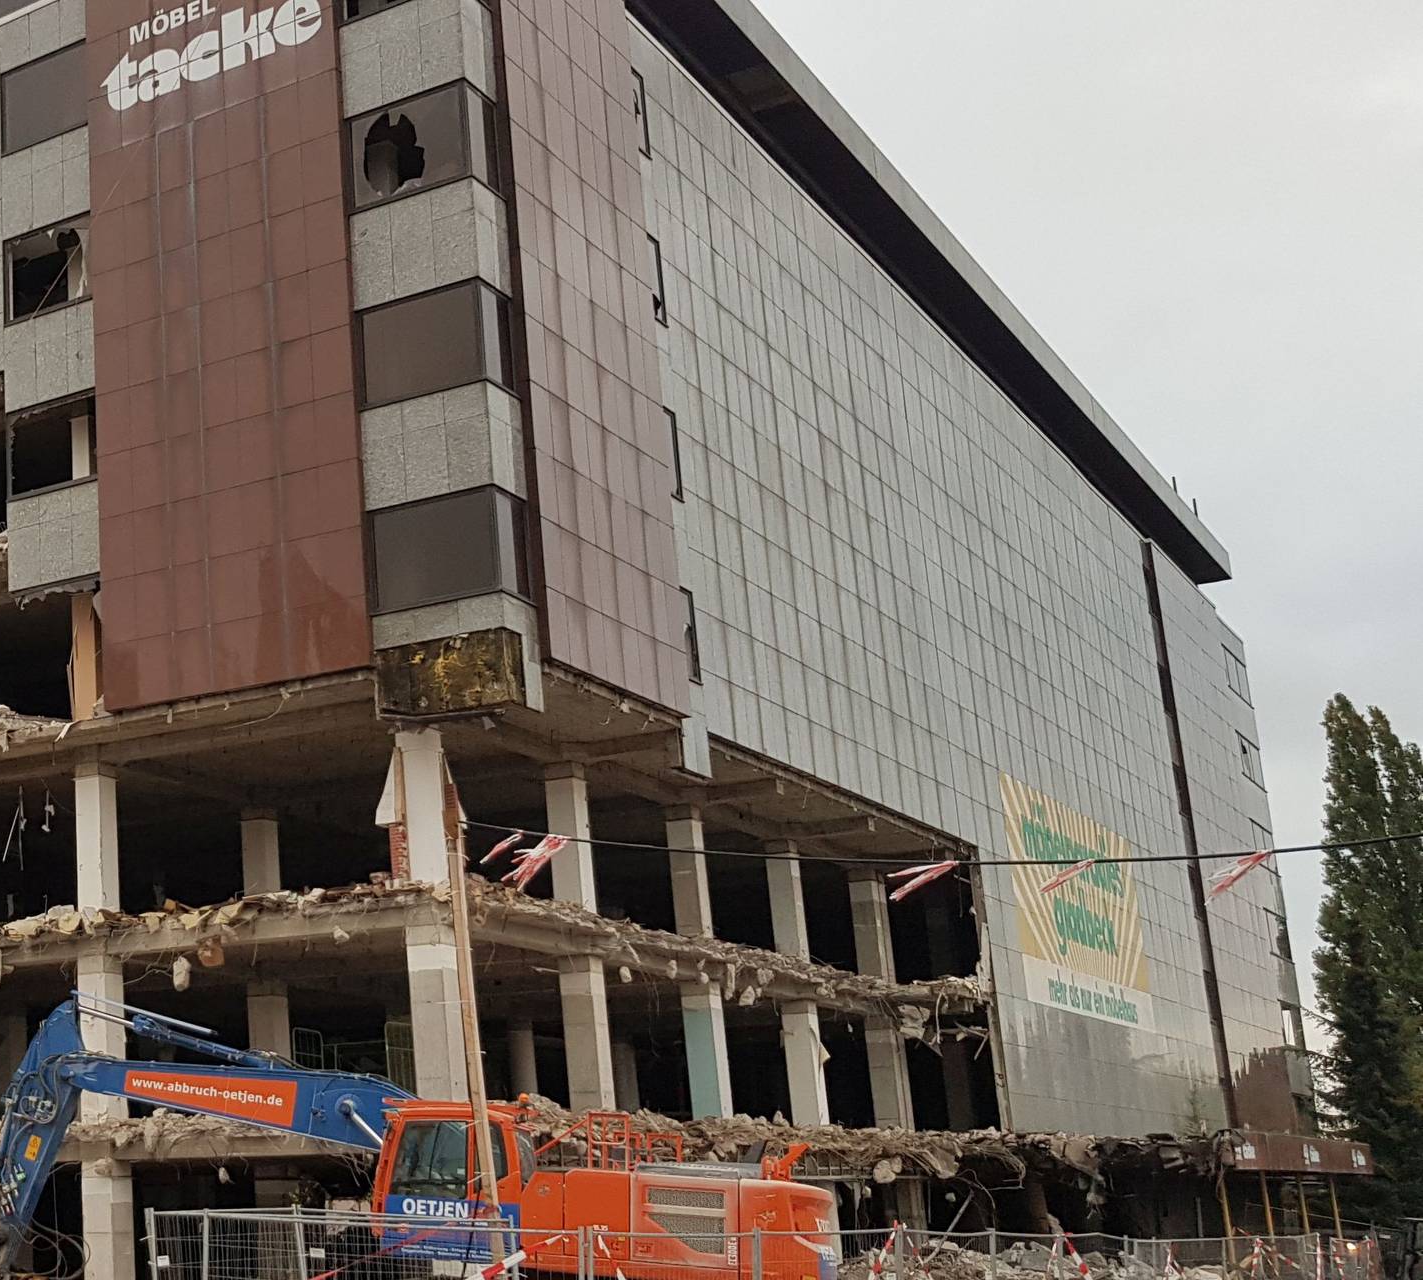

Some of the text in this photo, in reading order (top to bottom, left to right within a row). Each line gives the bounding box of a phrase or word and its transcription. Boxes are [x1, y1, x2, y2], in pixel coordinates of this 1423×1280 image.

[129, 0, 216, 46] MÖBEL
[100, 0, 322, 111] tacke
[131, 1077, 284, 1107] www.abbruch-oetjen.de
[401, 1198, 469, 1219] OETJEN
